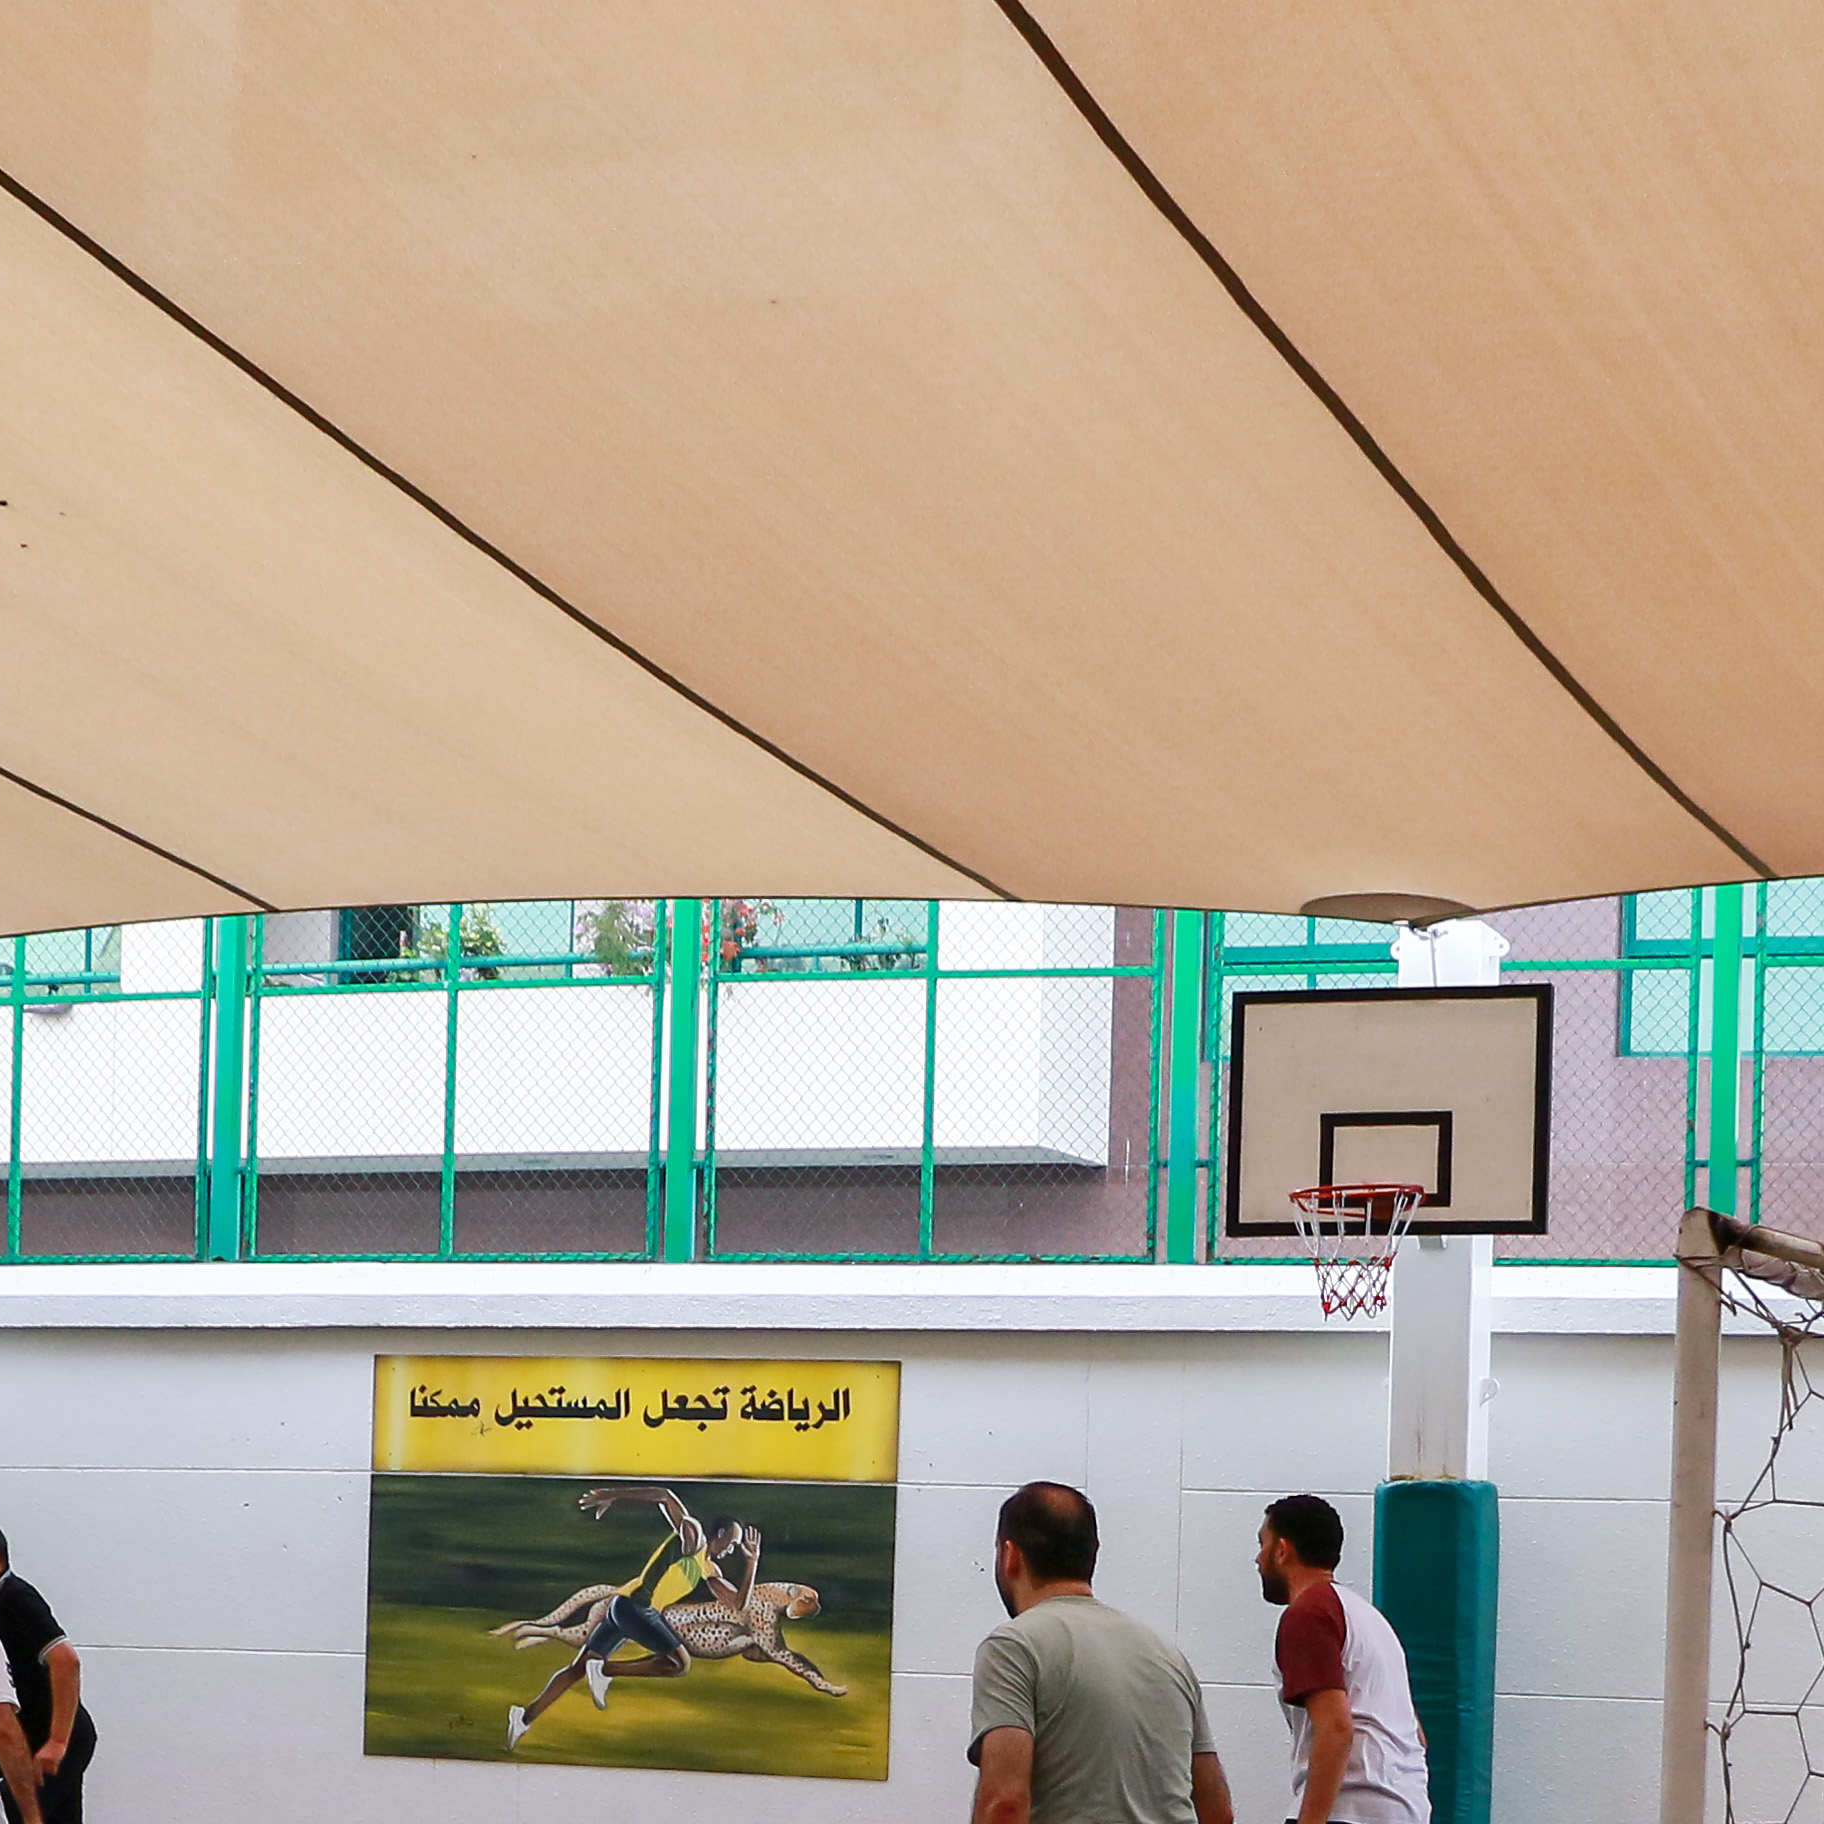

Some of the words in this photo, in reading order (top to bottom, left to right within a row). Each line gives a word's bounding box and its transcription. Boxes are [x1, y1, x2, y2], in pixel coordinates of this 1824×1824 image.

[494, 1385, 631, 1431] المستحيل
[643, 1384, 729, 1432] تجعل
[740, 1385, 851, 1433] الرياضة
